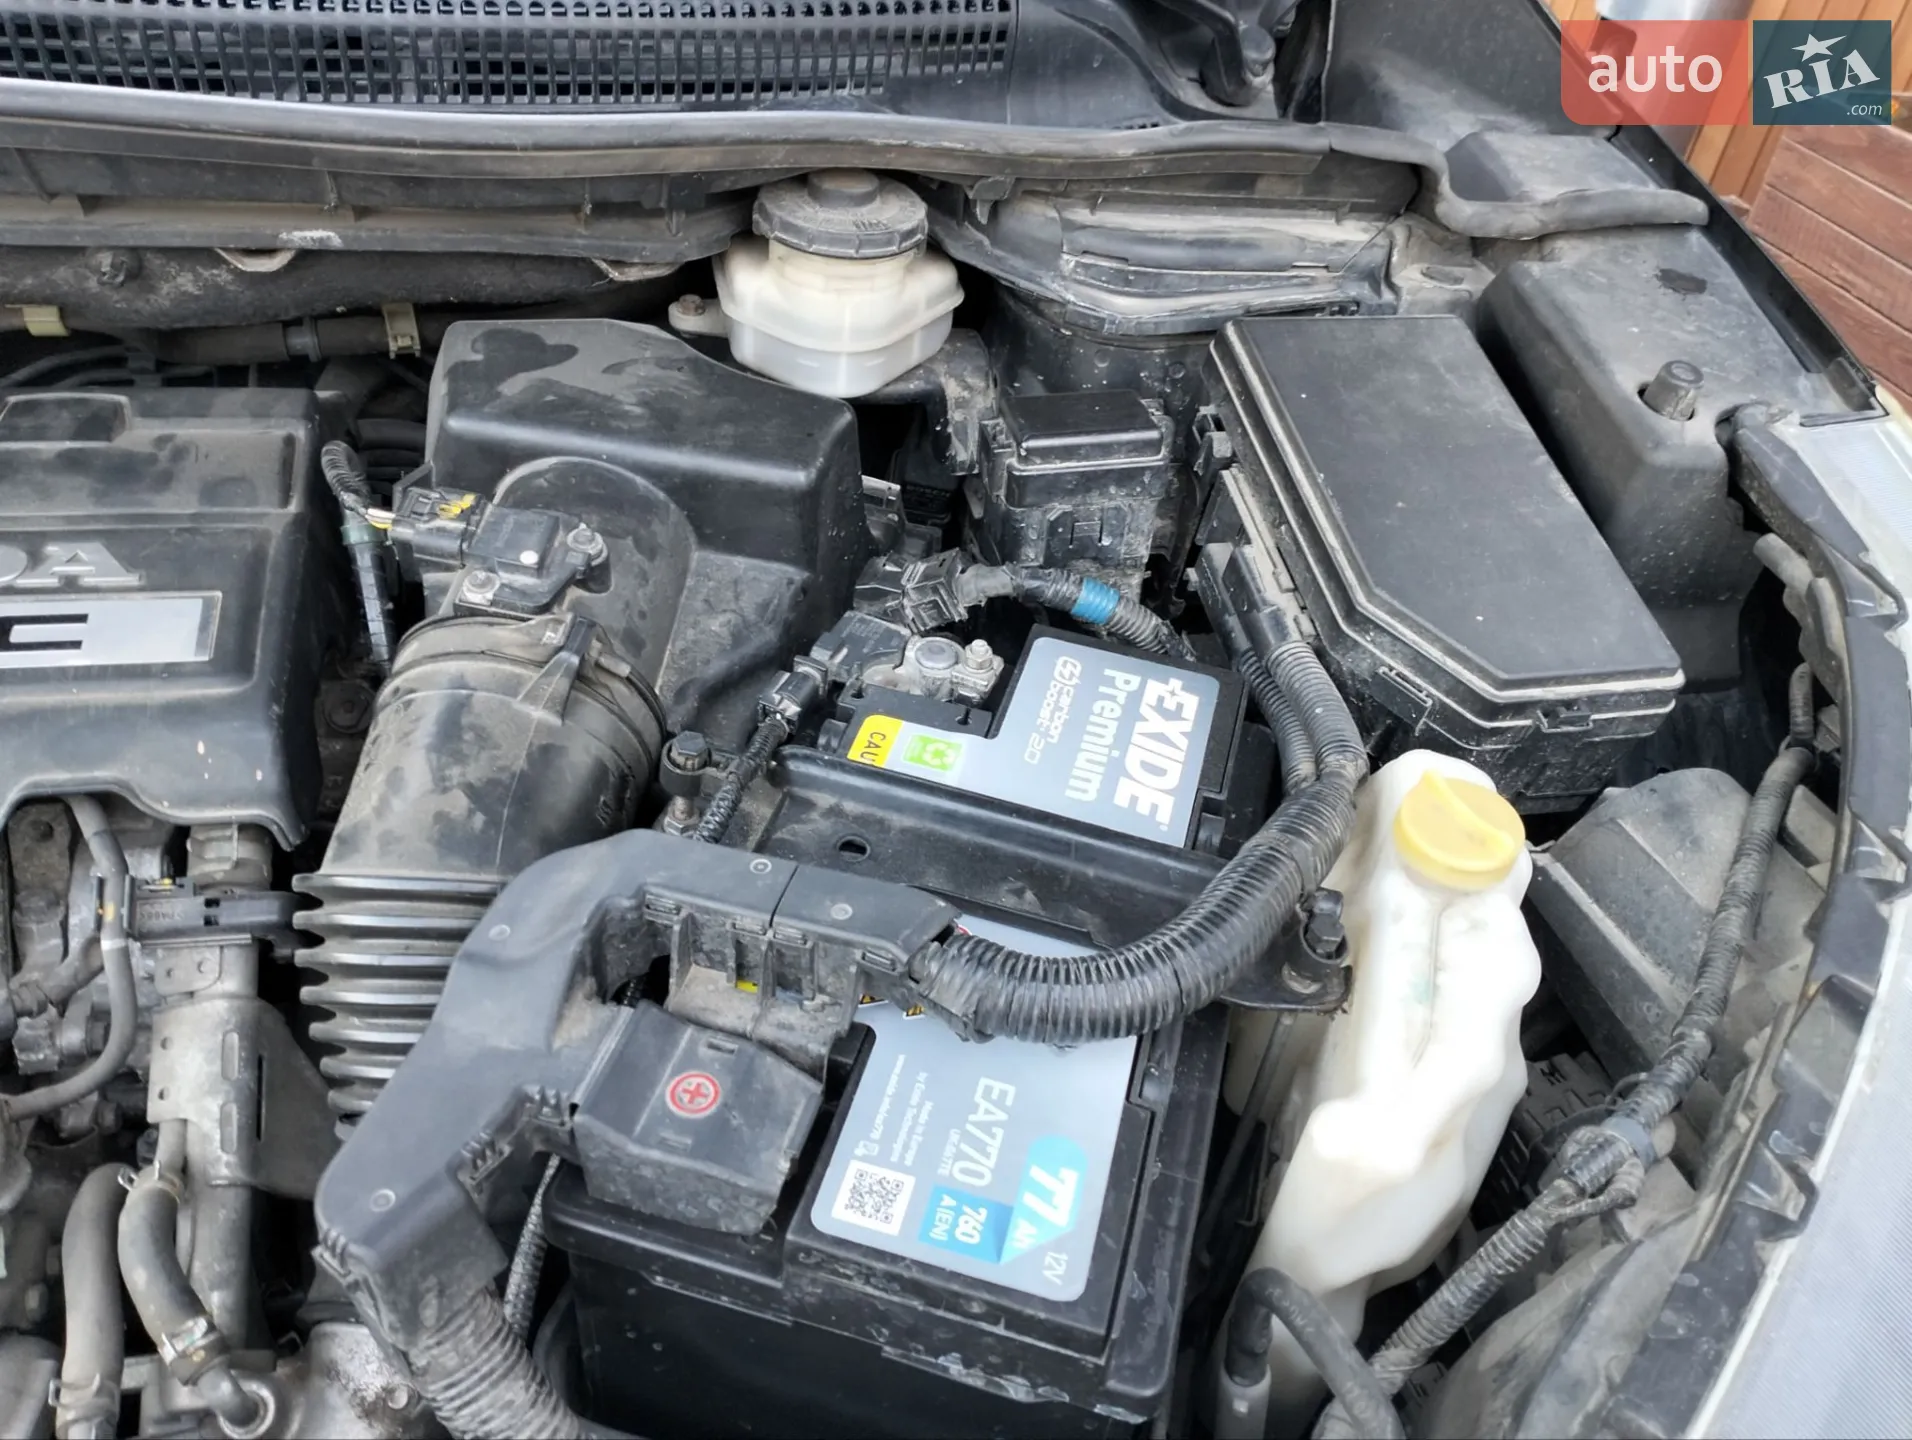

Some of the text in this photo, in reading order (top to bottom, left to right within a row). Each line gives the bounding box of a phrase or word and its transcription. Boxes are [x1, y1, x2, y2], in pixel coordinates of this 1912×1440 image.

[0, 541, 146, 588] A
[1064, 668, 1142, 802] Premium
[1114, 678, 1200, 825] EXIDE
[952, 1076, 1016, 1187] EA770
[928, 1207, 956, 1242] (EN)
[954, 1203, 989, 1245] 760
[1012, 1165, 1080, 1250] 77 Ah
[1042, 1251, 1069, 1286] 12V
